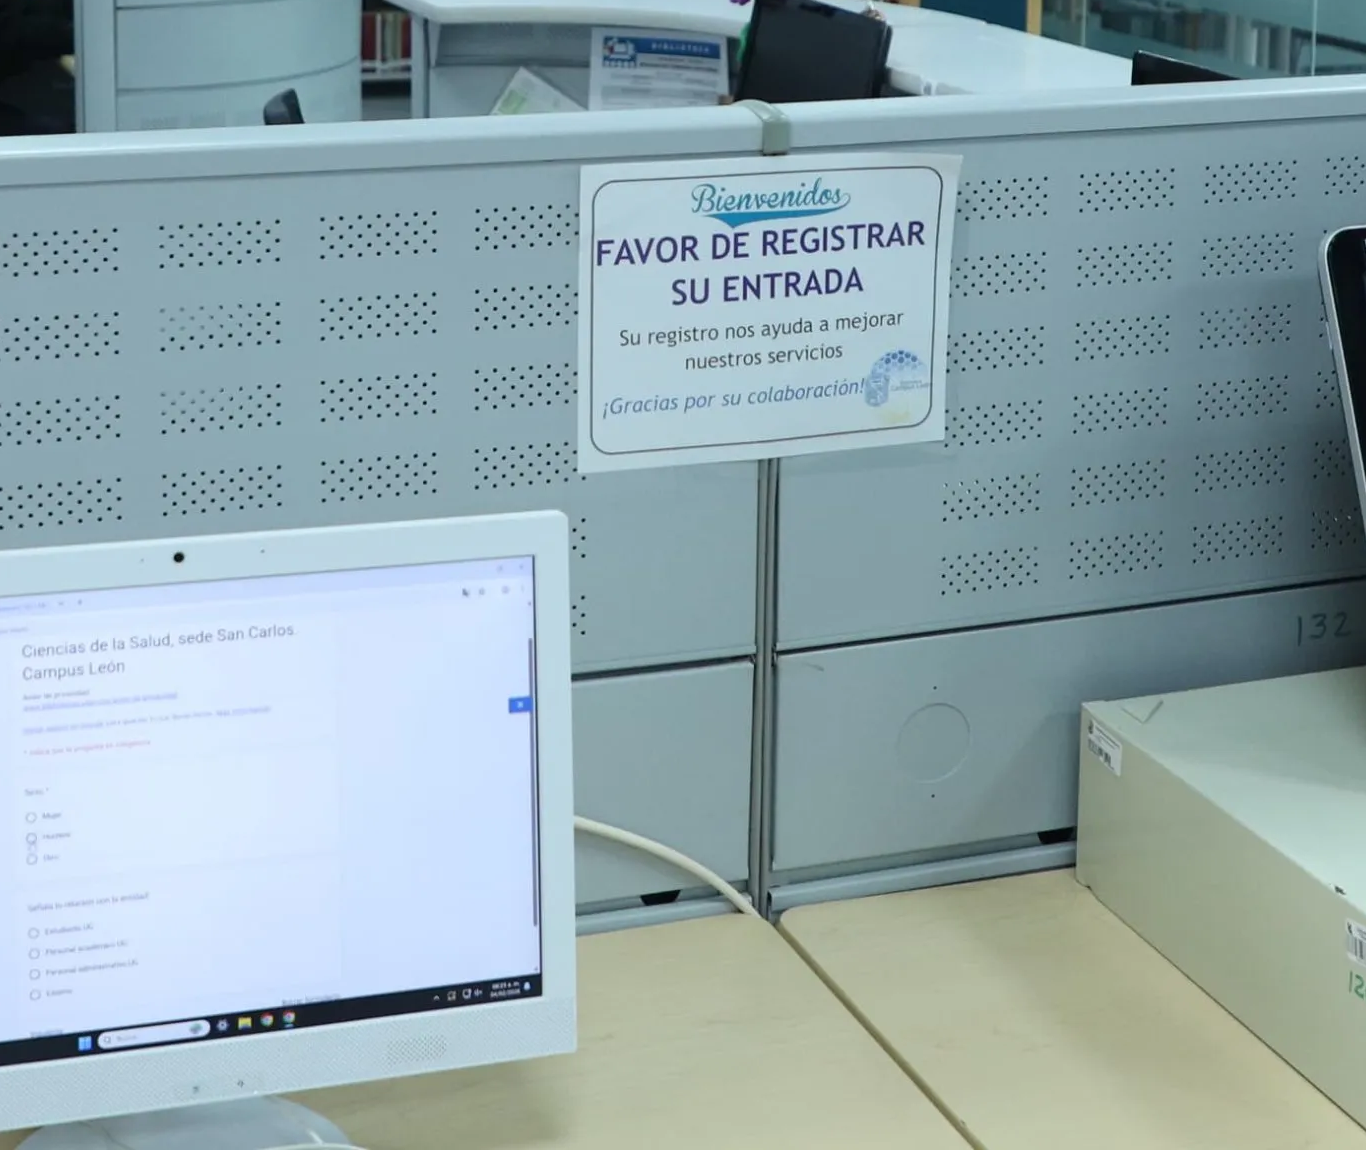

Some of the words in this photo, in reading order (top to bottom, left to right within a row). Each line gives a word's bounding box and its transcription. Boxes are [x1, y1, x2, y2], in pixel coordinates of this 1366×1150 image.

[691, 177, 850, 214] Bienvenidos
[596, 235, 700, 267] FAVOR
[711, 232, 750, 260] DE
[762, 220, 925, 257] REGISTRAR
[671, 278, 710, 306] SU
[723, 266, 864, 302] ENTRADA
[619, 329, 641, 347] Su
[647, 326, 719, 351] registro
[725, 325, 755, 340] nos
[761, 318, 814, 341] ayuda
[819, 320, 829, 333] a
[835, 311, 904, 335] mejorar
[685, 353, 763, 371] nuestros
[767, 344, 844, 364] servicios
[603, 397, 679, 420] ¡Gracias
[683, 395, 714, 413] por
[721, 393, 741, 407] su
[747, 378, 865, 406] colaboración!
[22, 640, 86, 659] Ciencias
[90, 639, 108, 653] de
[112, 637, 126, 651] la
[129, 632, 174, 649] Salud,
[178, 629, 213, 646] sede
[217, 627, 245, 642] San
[1295, 610, 1352, 647] 132
[22, 662, 85, 682] Campus
[88, 660, 125, 677] León
